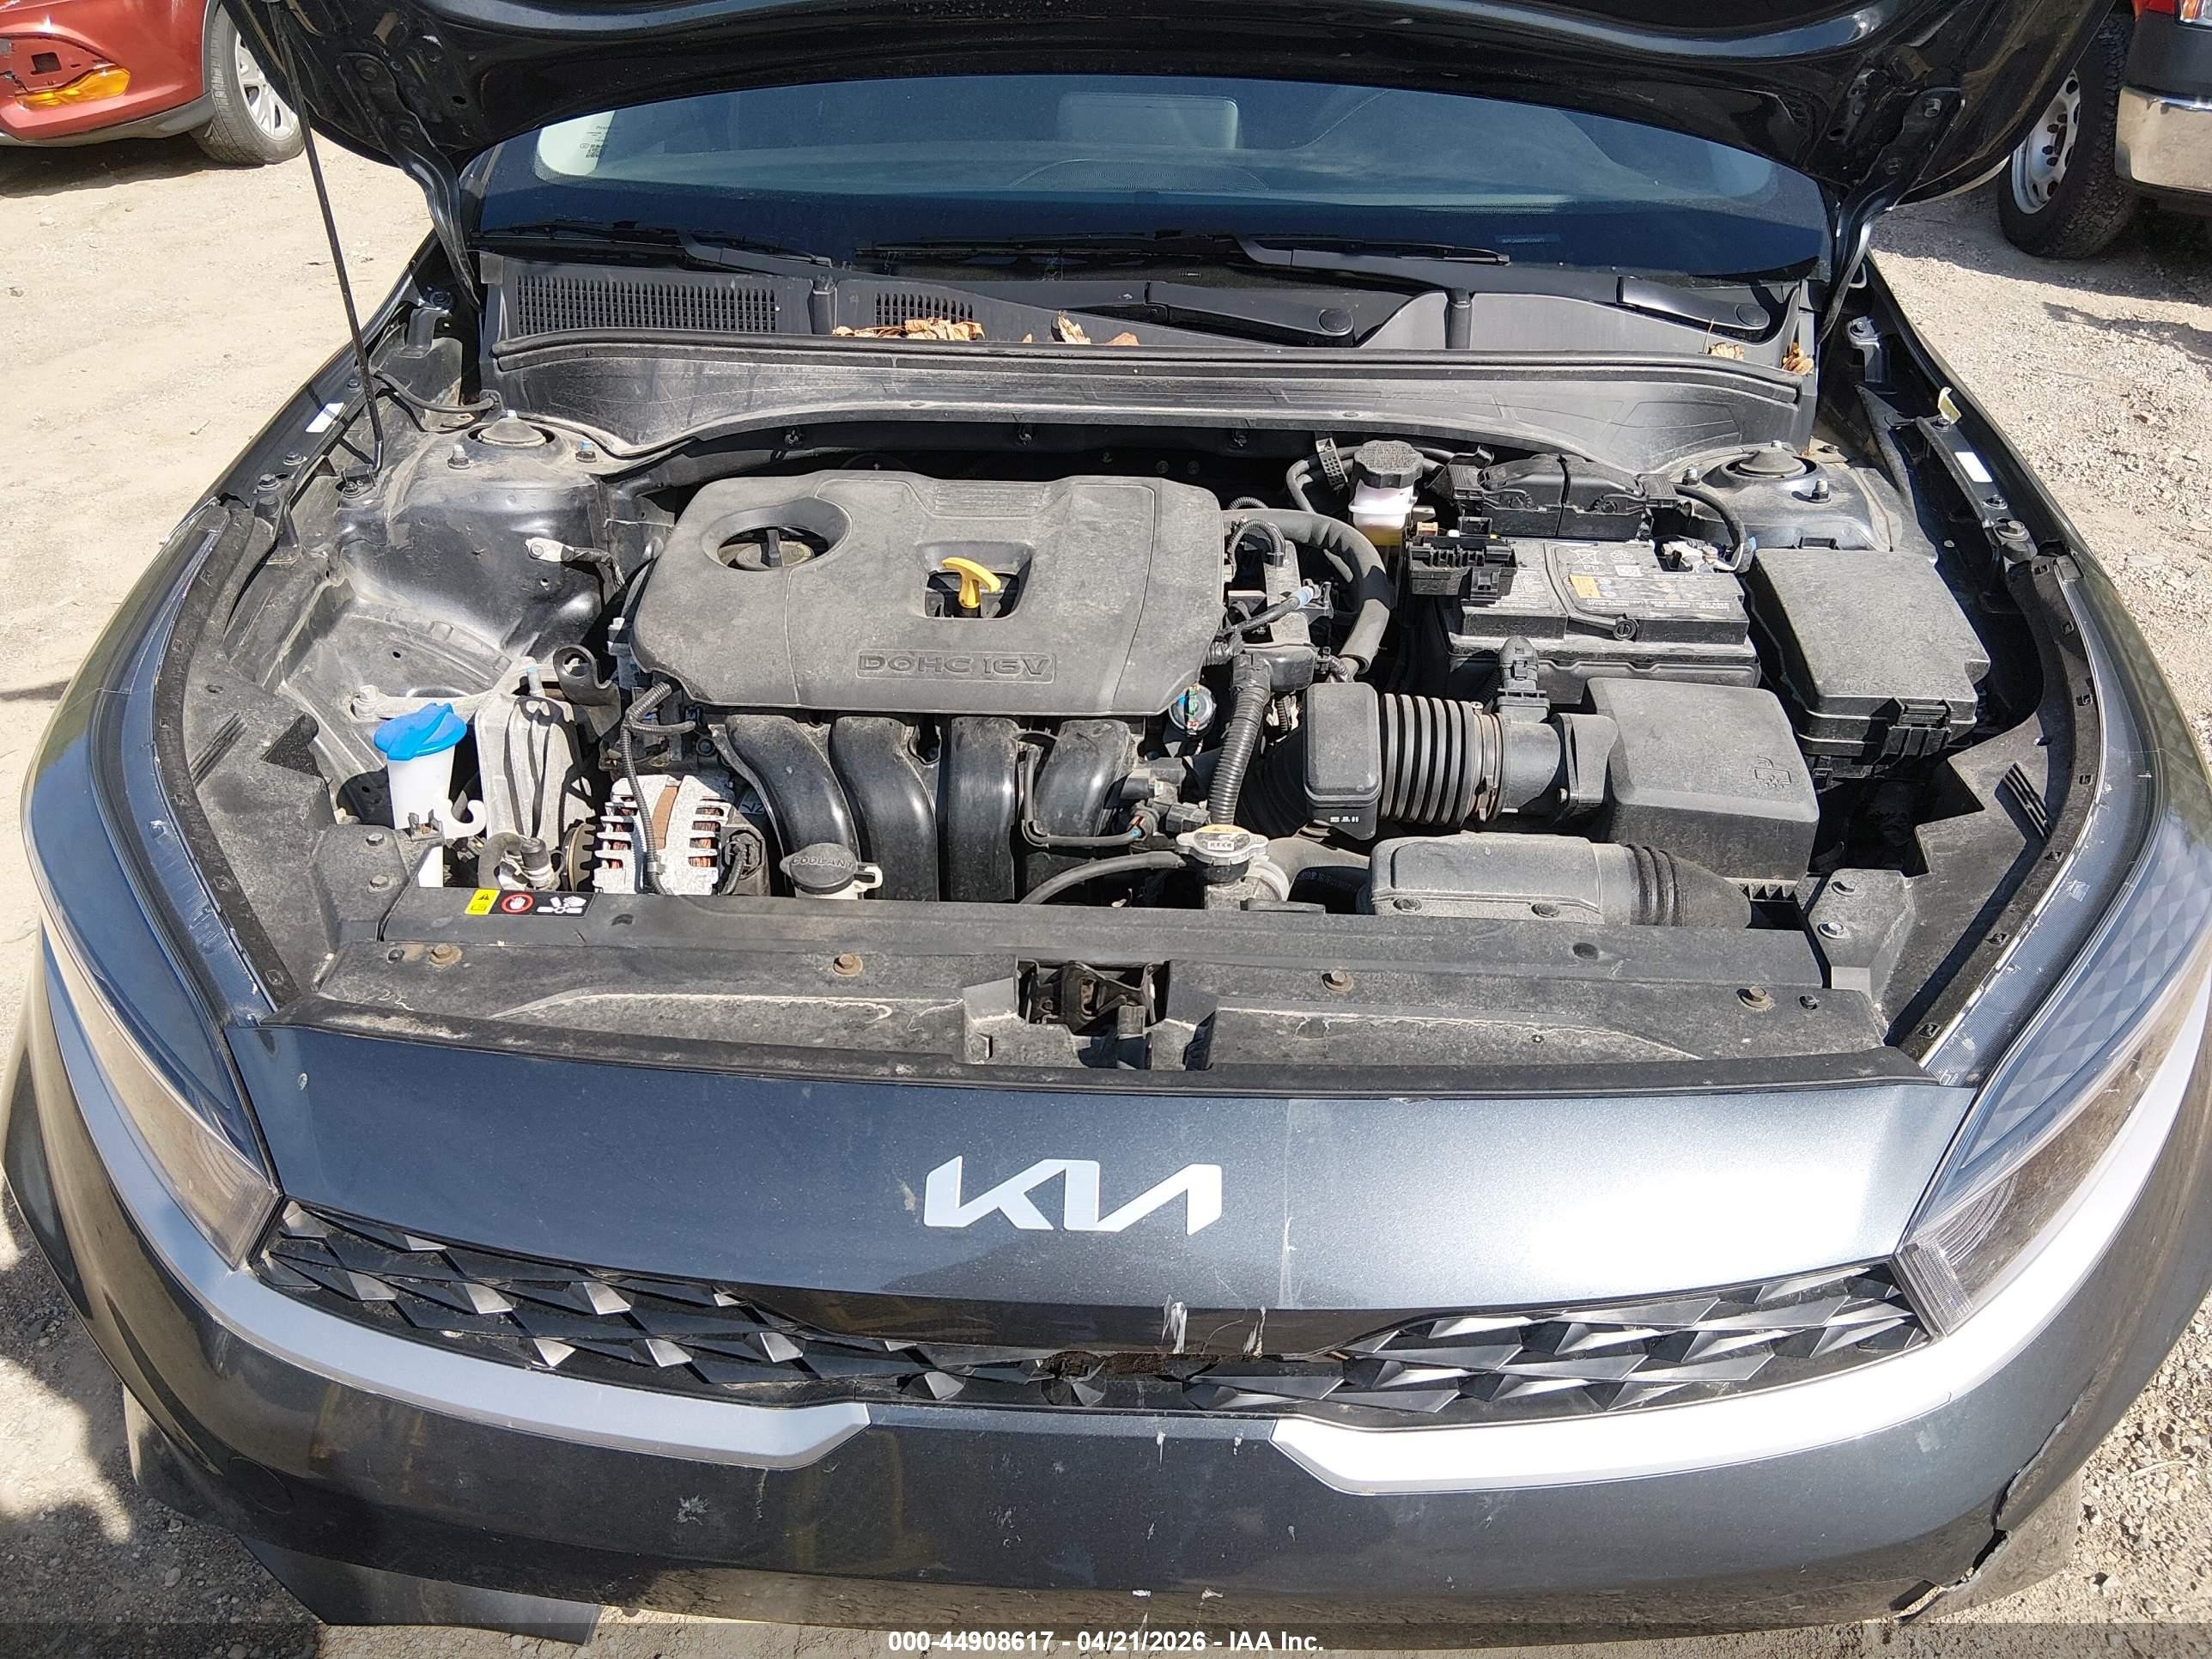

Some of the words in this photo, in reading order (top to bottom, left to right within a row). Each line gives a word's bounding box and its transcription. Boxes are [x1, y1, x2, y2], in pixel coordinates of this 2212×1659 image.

[859, 654, 974, 673] DOHC
[983, 658, 1051, 676] 16V
[791, 857, 854, 869] COOLANT
[923, 1155, 1222, 1236] KIA
